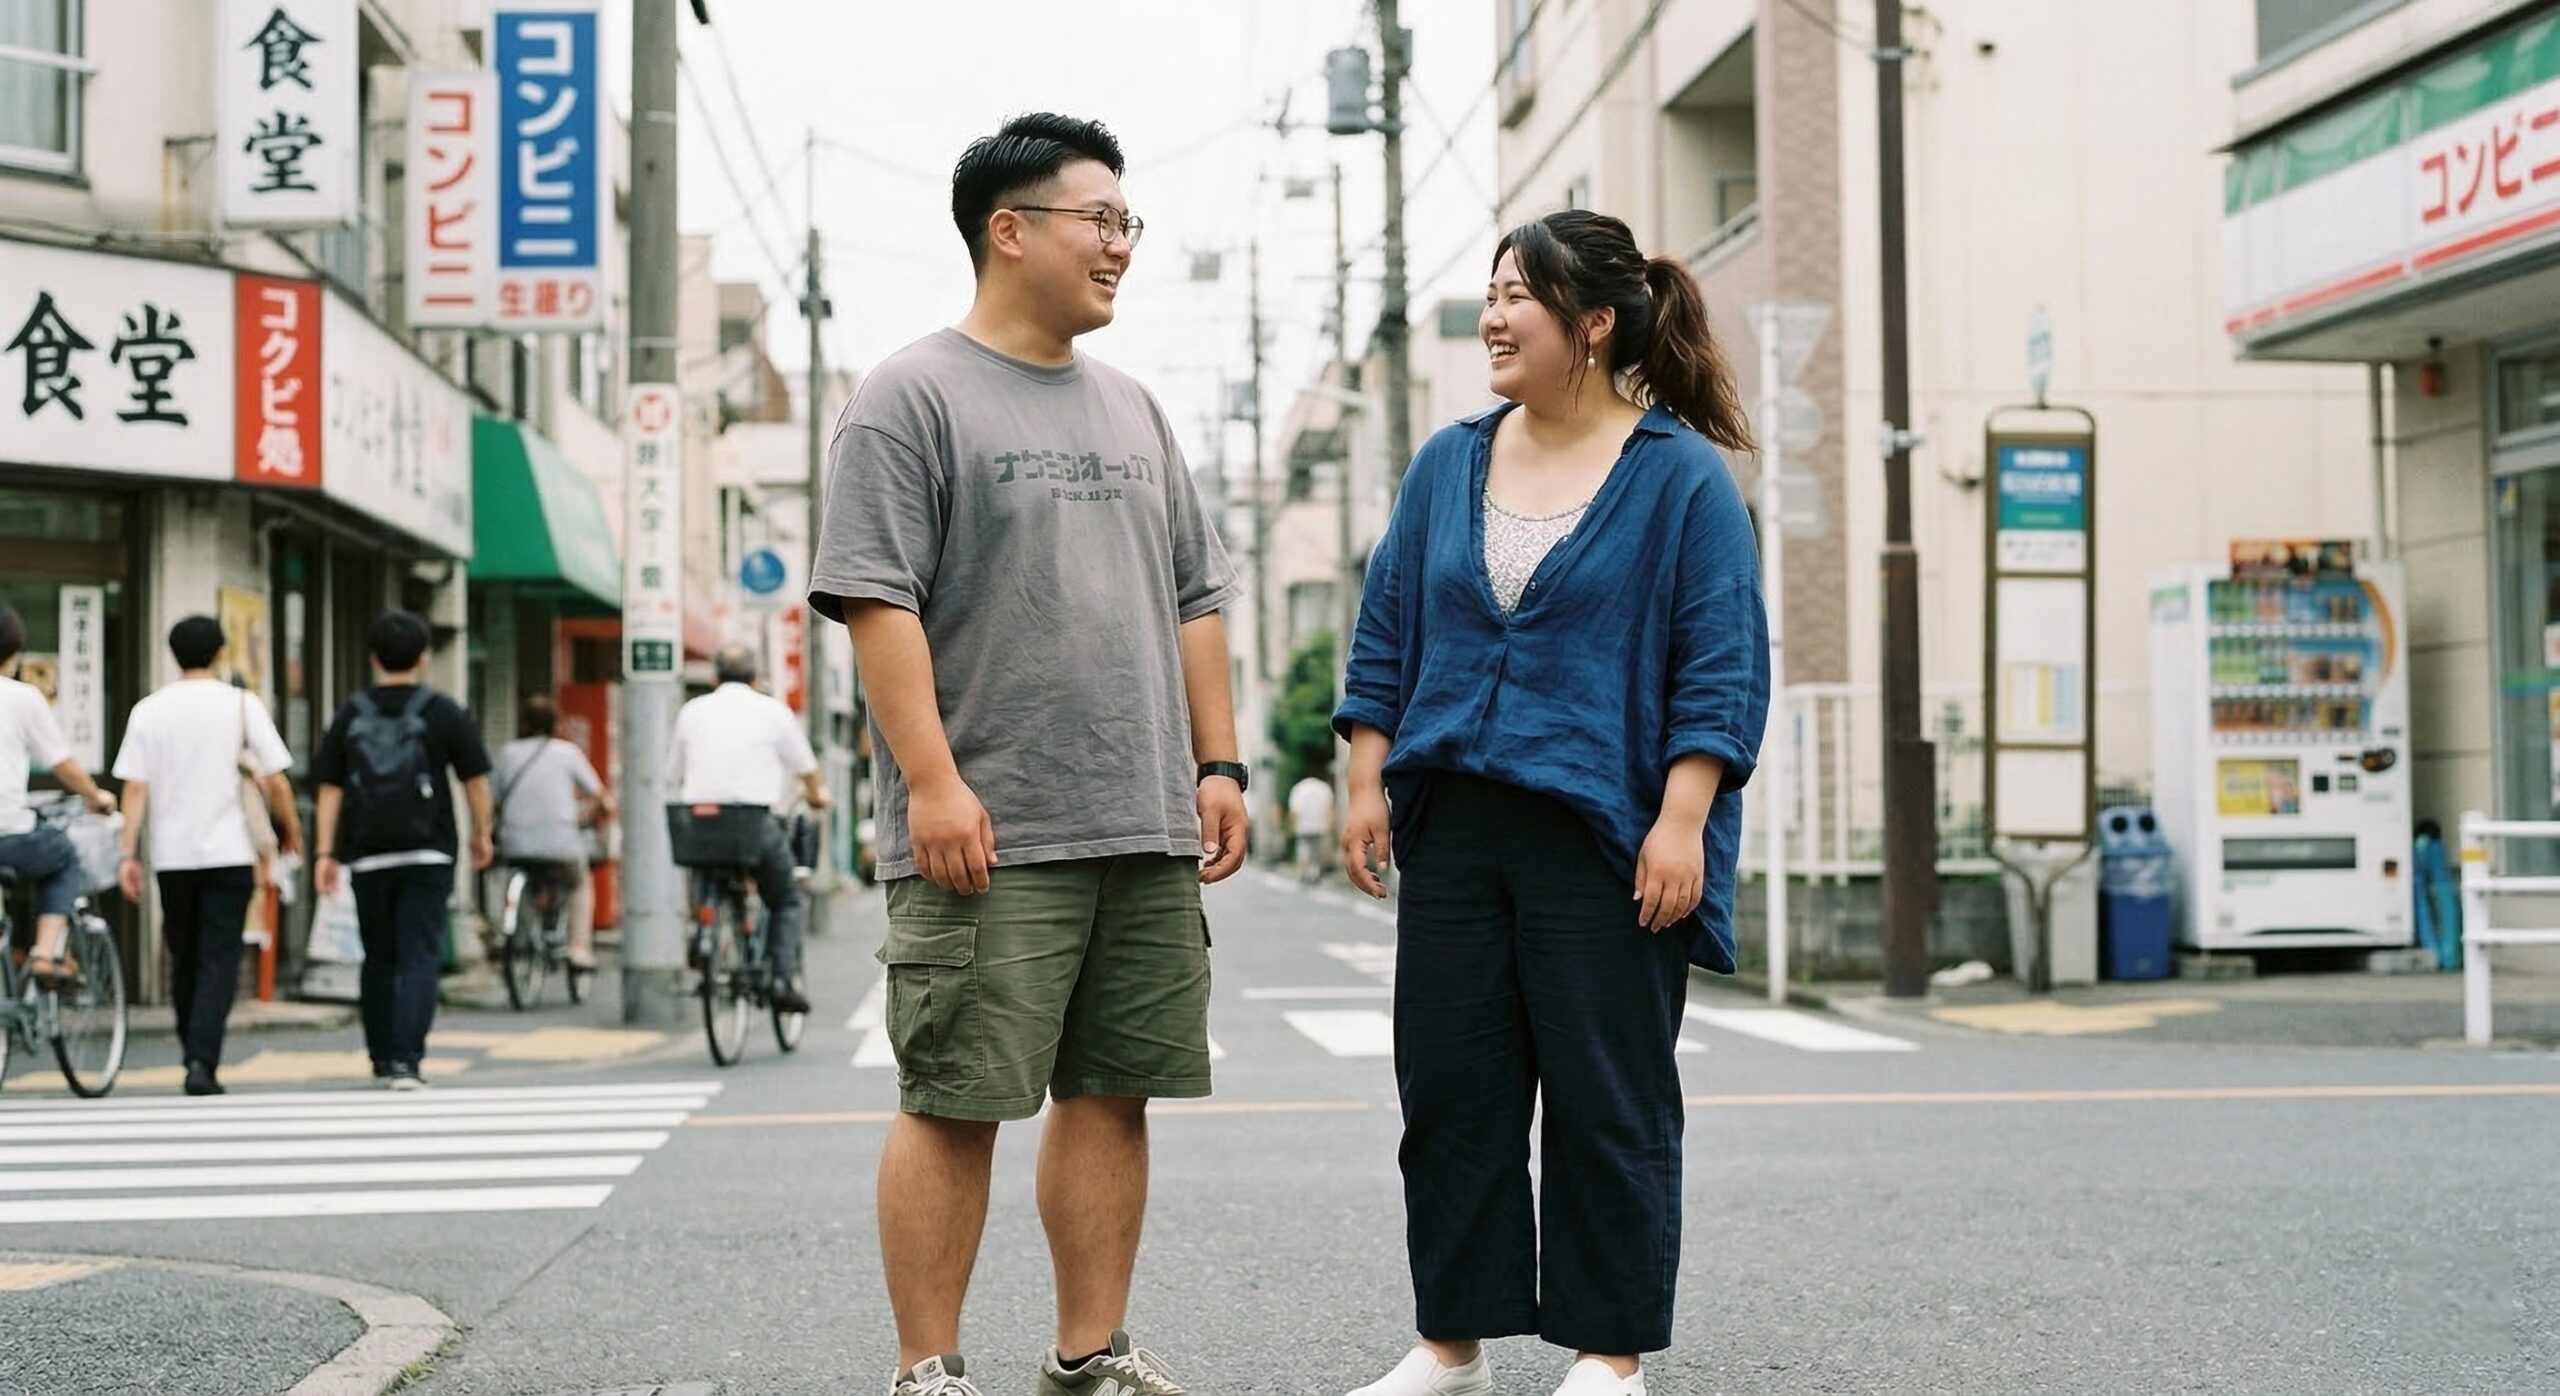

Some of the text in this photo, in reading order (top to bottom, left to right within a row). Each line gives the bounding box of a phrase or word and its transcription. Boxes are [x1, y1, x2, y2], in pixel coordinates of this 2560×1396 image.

[244, 8, 323, 193] 食堂
[517, 22, 578, 256] コンビニ
[2421, 109, 2560, 225] コンビニ
[425, 91, 474, 305] コンビニ
[6, 290, 196, 426] 食堂
